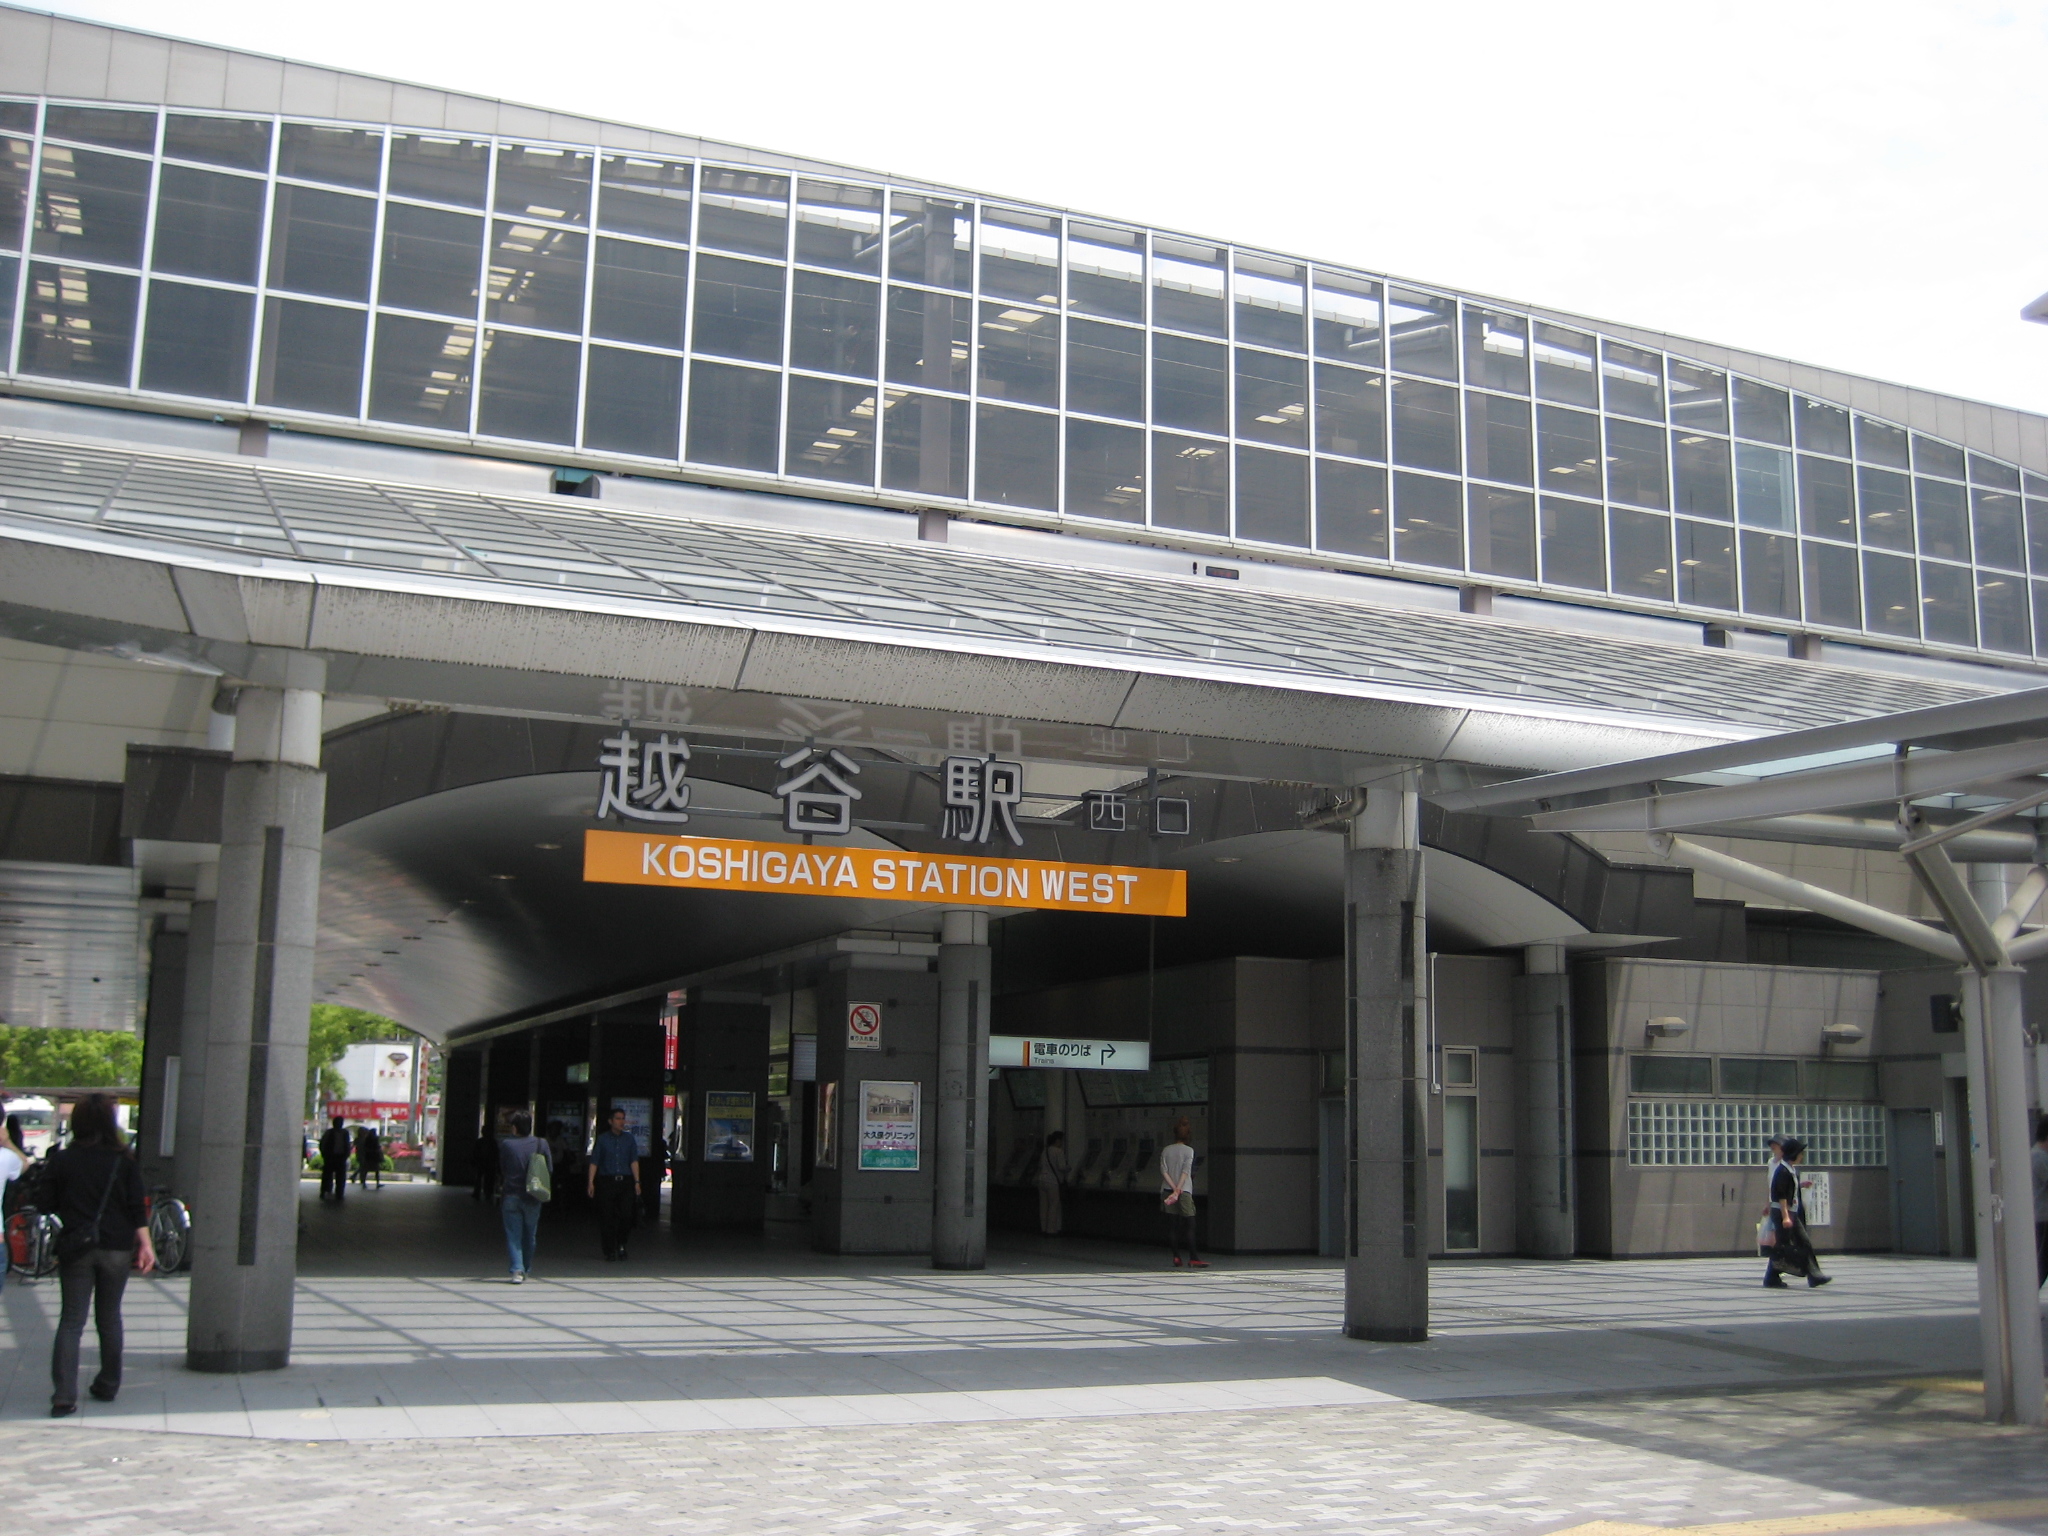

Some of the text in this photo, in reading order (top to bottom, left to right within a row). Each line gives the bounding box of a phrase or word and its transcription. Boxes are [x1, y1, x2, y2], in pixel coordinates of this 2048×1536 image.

[597, 730, 1024, 846] 越谷駅
[642, 843, 1138, 905] KOSHIGAYA STATION WEST
[1034, 1042, 1092, 1057] 電車のりば
[863, 1131, 915, 1140] 大久保クリニック
